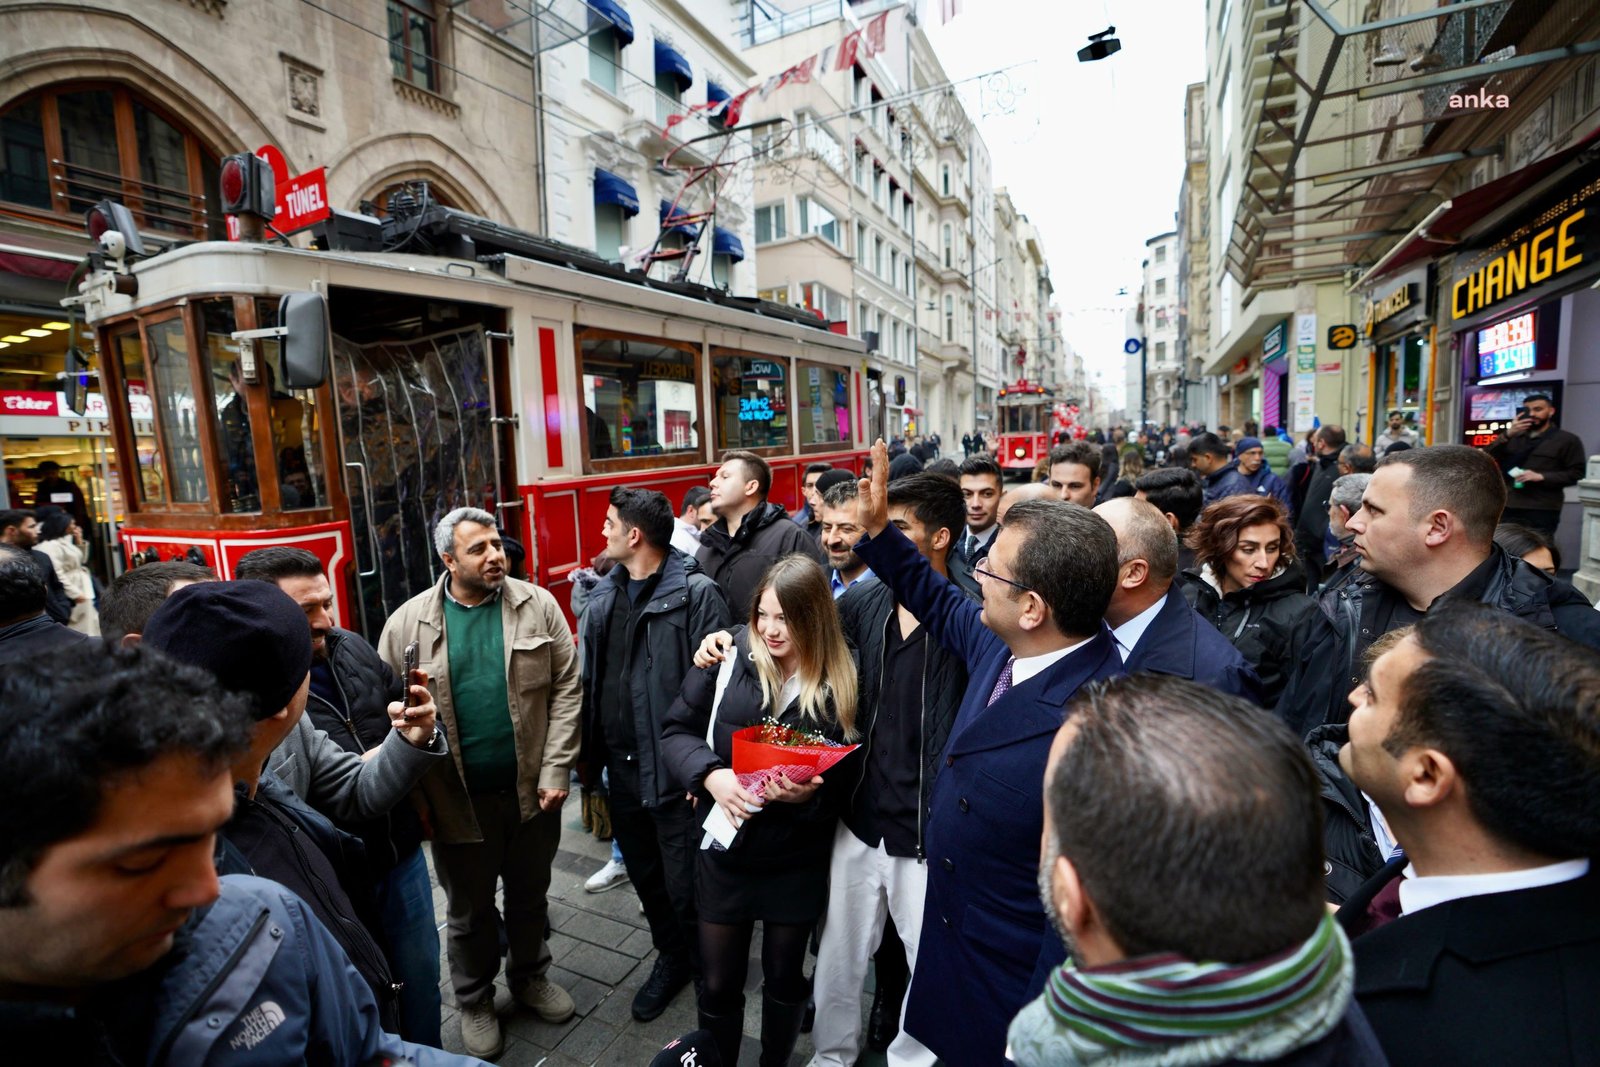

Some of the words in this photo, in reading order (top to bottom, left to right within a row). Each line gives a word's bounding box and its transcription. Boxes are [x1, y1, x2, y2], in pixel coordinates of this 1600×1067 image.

[285, 183, 325, 219] TÜNEL
[1452, 208, 1585, 320] CHANGE
[229, 1015, 267, 1050] NORTH
[241, 1006, 262, 1027] THE
[245, 1022, 272, 1050] FACE
